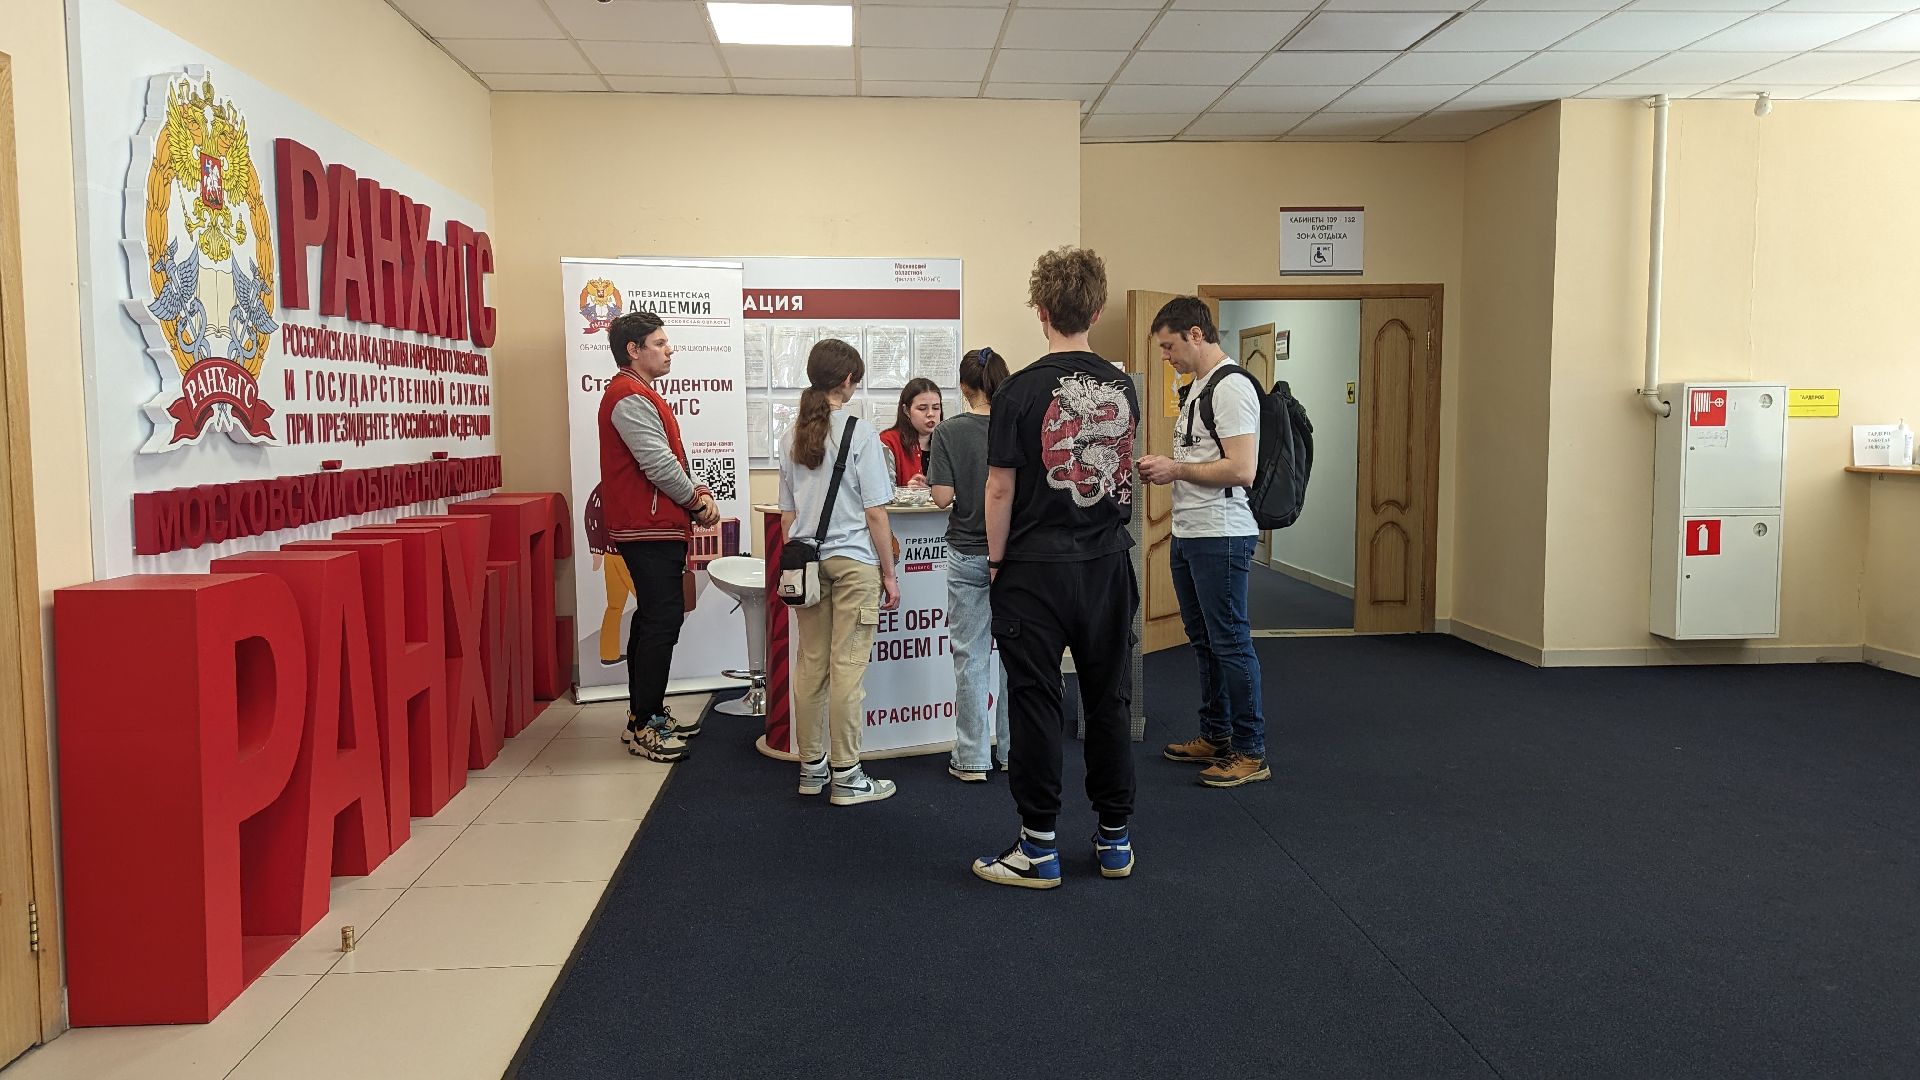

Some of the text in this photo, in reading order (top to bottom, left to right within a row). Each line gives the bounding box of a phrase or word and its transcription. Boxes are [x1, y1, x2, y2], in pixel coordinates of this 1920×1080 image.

[276, 138, 496, 348] РАНХиГС
[1296, 232, 1348, 240] ЗОНА ОТДЫХА
[628, 290, 710, 299] ПРЕЗИДЕНТСКАЯ
[629, 299, 711, 315] АКАДЕМИЯ
[743, 294, 803, 314] АЦИЯ
[282, 323, 489, 376] РОССИЙСКАЯ АКАДЕМИЯ НАРОДНОГО ХОЗЯЙСТВА
[687, 345, 732, 353] ШКОЛЬНИКОВ
[184, 366, 256, 410] РАНХиГС
[284, 369, 490, 408] И ГОСУДАРСТВЕННОЙ СЛУЖБЫ
[285, 410, 491, 447] ПРИ ПРЕЗИДЕНТЕ РОССИЙСКОЙ ФЕДЕРАЦИИ
[134, 451, 503, 556] МОСКОВСКИЙ ОБЛАСТНОЙ ФИЛИАЛ
[905, 546, 948, 560] АКАДЕ
[54, 492, 573, 1027] РАНХиГС
